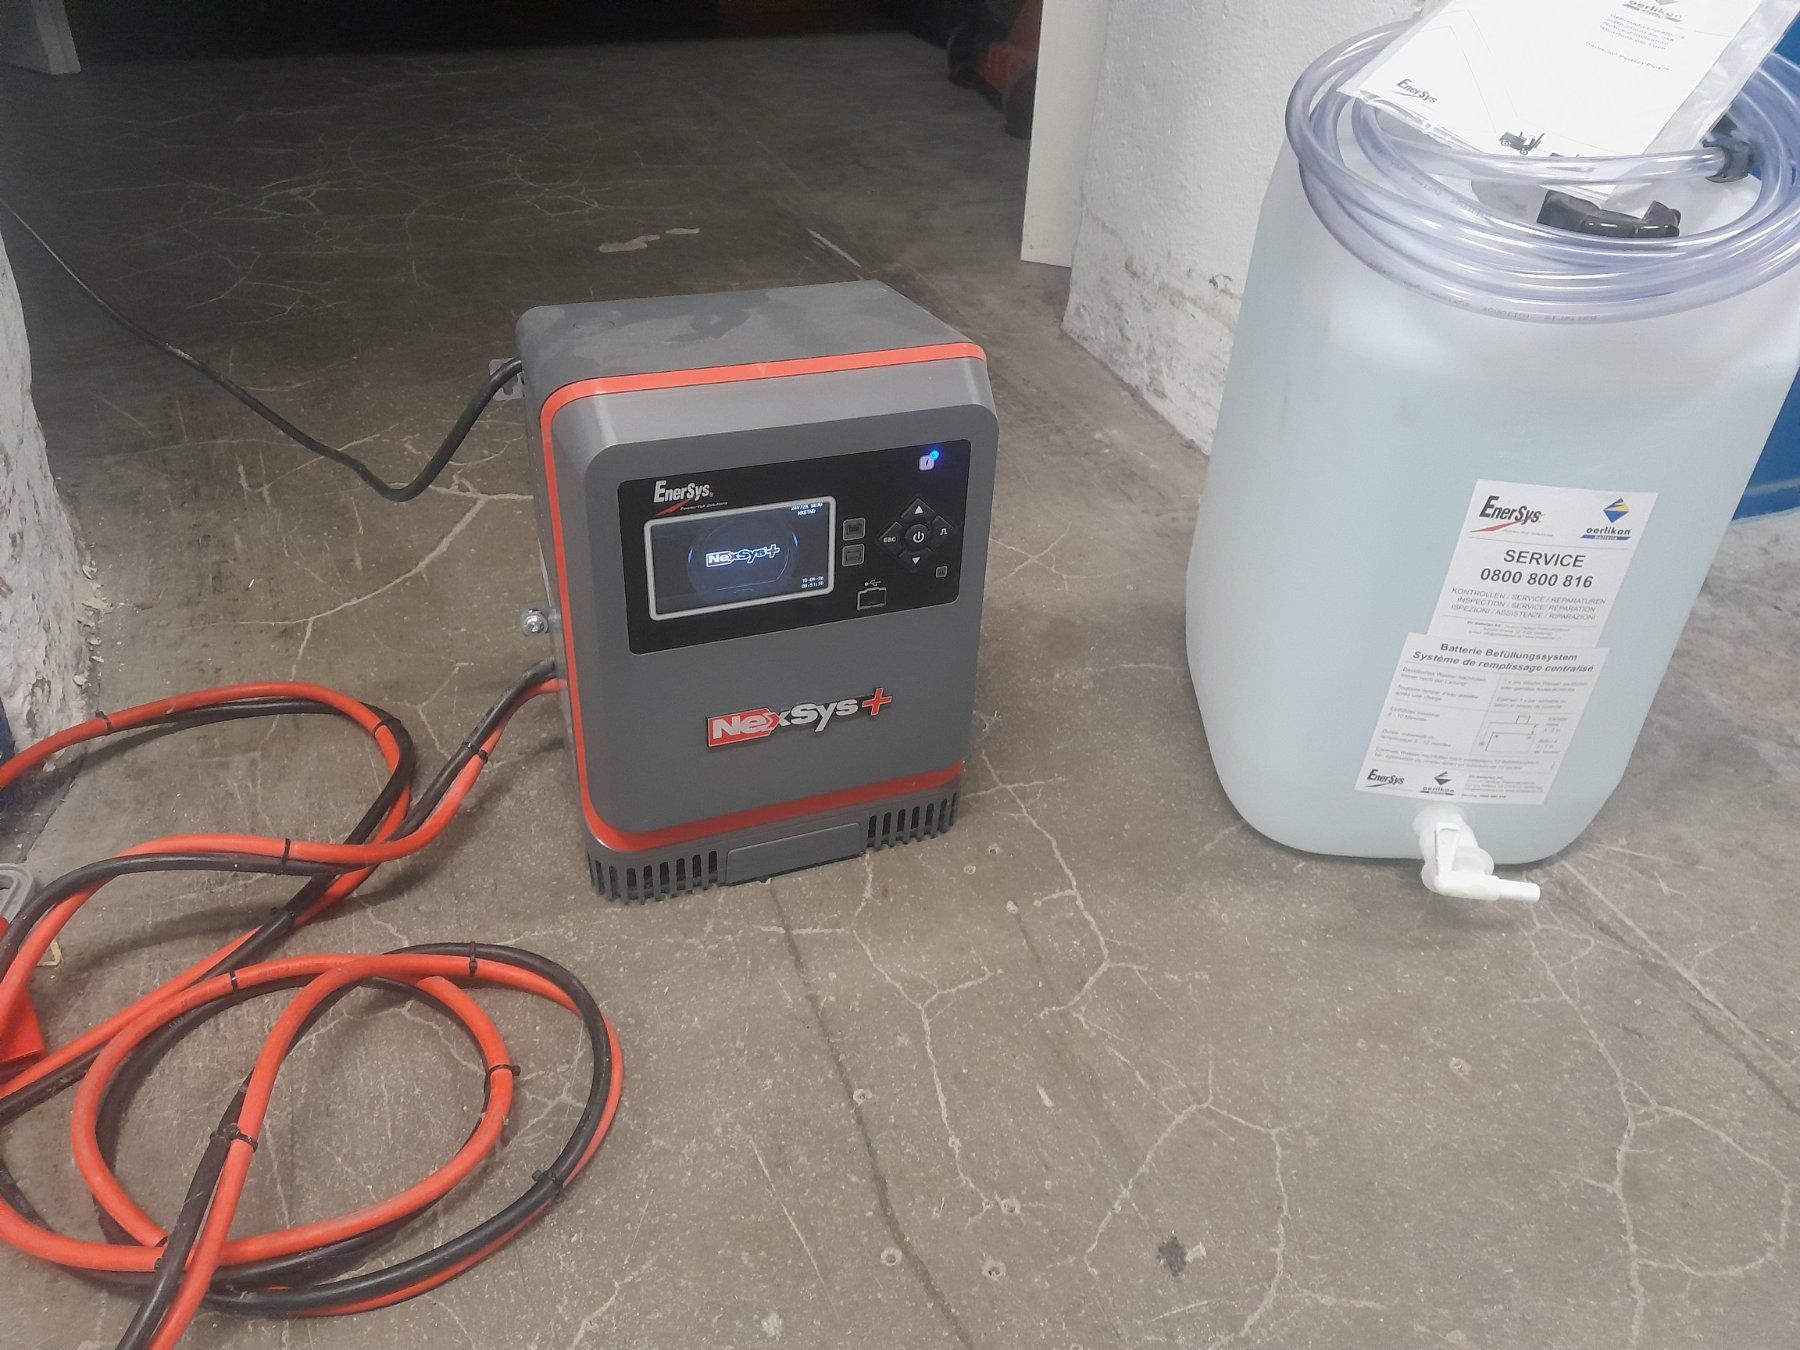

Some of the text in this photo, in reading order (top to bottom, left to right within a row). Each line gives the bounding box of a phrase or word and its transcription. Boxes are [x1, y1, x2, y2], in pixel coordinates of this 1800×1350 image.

[1396, 78, 1438, 103] EnerSys
[653, 480, 711, 501] EnerSys
[1479, 495, 1542, 526] EnerSys
[1586, 526, 1631, 535] oerlikon
[1503, 549, 1586, 568] SERVICE
[1480, 568, 1594, 589] 0800 800 816
[1452, 588, 1505, 599] KONTROLLEN
[1511, 594, 1545, 603] SERVICE
[1551, 597, 1606, 605] REPARATUREN
[1457, 597, 1506, 607] INSPECTION
[1451, 604, 1491, 614] ISPEZIONI
[1412, 650, 1594, 673] Système de remplissage centralisé
[1440, 643, 1578, 662] Batterie Befüllungssystem
[1367, 769, 1405, 785] EnerSys
